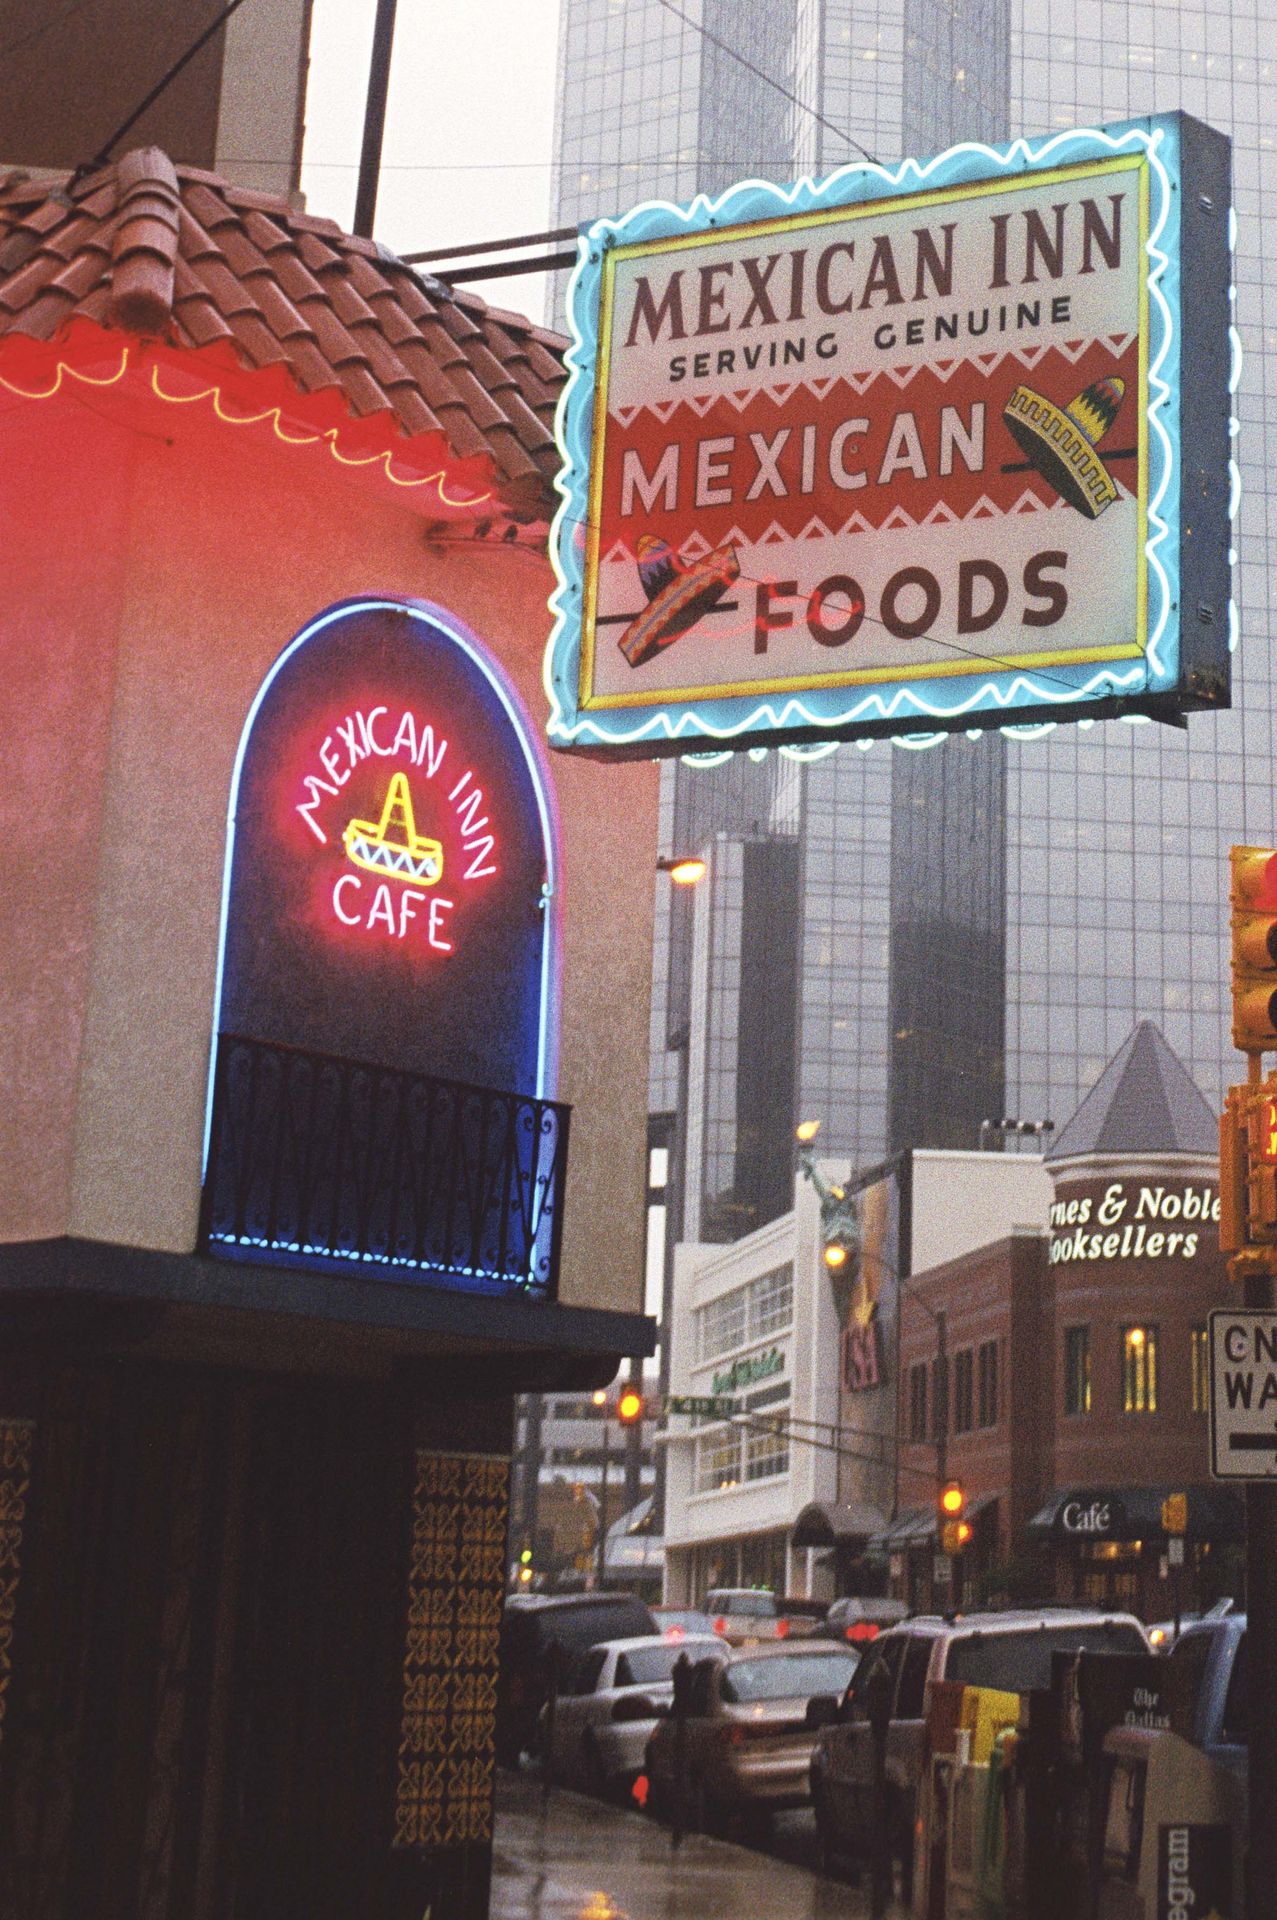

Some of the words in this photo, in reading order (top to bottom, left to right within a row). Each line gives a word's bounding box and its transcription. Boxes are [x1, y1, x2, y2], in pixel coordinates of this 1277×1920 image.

[624, 222, 958, 347] MEXICAN
[988, 193, 1127, 289] INN
[669, 332, 838, 382] SERVING
[873, 296, 1072, 350] GENUINE
[620, 402, 986, 518] MEXICAN
[753, 550, 1069, 655] FOODS
[296, 706, 448, 844] MEXICAN
[448, 770, 497, 880] INN
[332, 874, 454, 951] CAFE
[1048, 1225, 1198, 1265] ooksellers
[1097, 1183, 1128, 1226] &
[1134, 1186, 1220, 1221] Noble
[1062, 1500, 1110, 1532] Café
